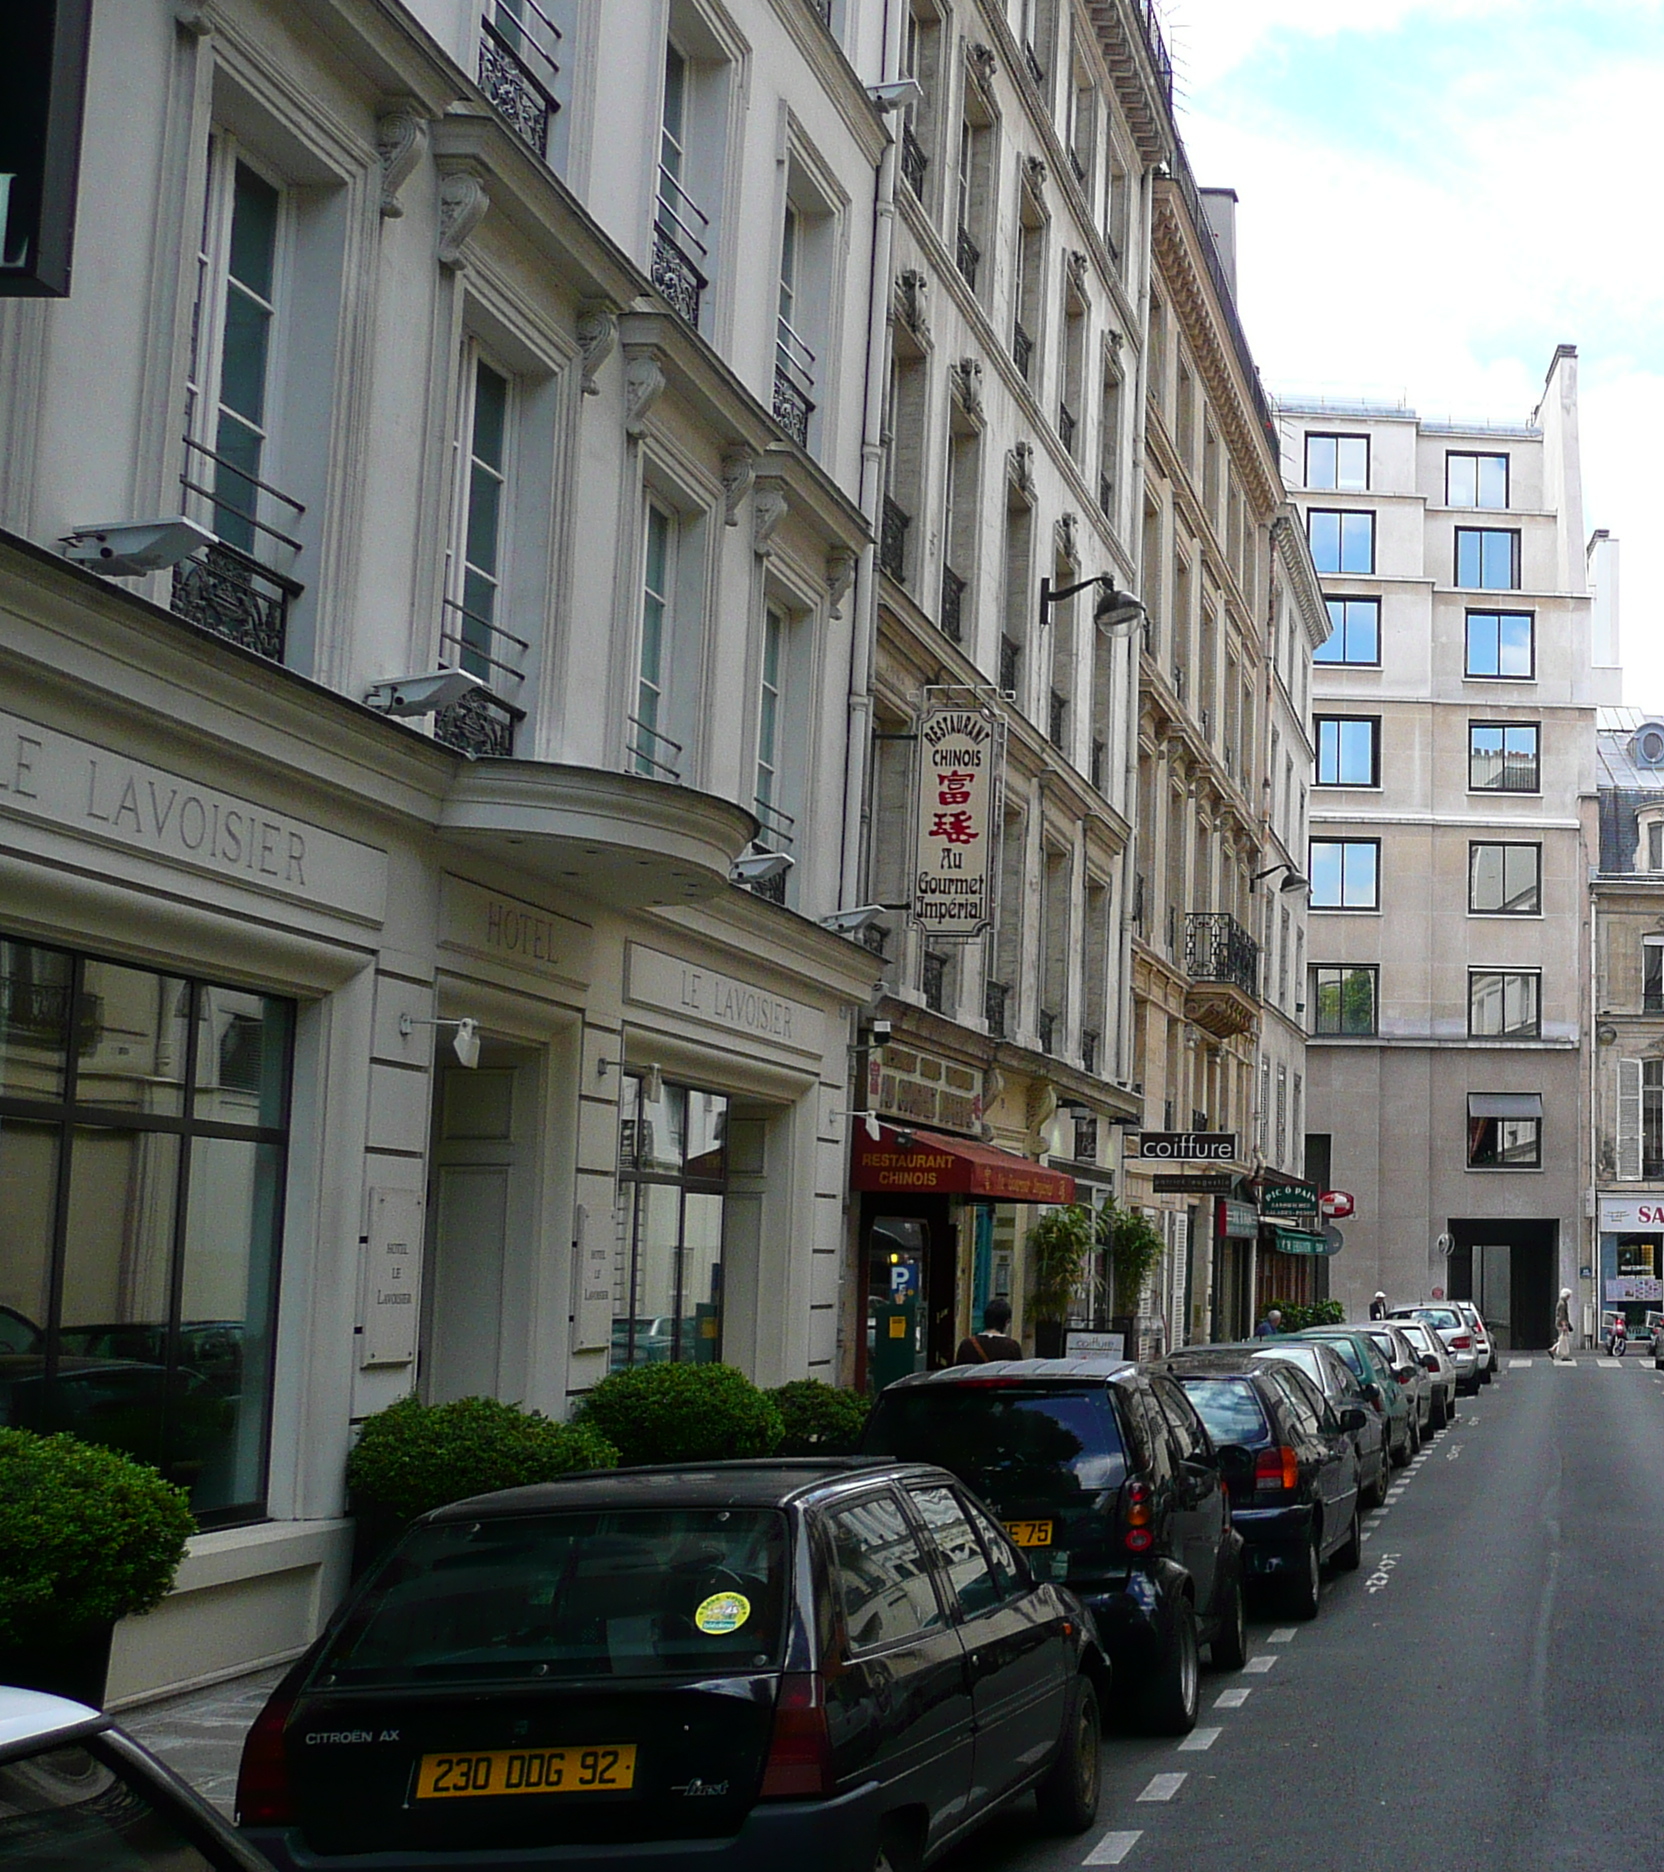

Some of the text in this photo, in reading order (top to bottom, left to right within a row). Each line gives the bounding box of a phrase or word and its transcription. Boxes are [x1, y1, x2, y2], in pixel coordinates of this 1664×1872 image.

[923, 714, 991, 748] RESTAURANT
[931, 748, 982, 768] CHINOIS
[0, 733, 307, 886] E LAVOISIER
[940, 847, 963, 870] Au
[918, 870, 985, 896] Gourmet
[916, 895, 983, 924] Impérial
[486, 901, 560, 965] HOTEL
[680, 970, 793, 1040] LE LAVOISIER
[1143, 1134, 1232, 1158] coiffure
[862, 1153, 955, 1169] RESTAURANT
[878, 1171, 938, 1186] CHINOIS
[1264, 1188, 1282, 1202] PIC
[1294, 1187, 1316, 1202] PAIN
[891, 1266, 910, 1290] P
[1025, 1522, 1050, 1543] 75
[305, 1729, 400, 1744] CITROËN AX
[432, 1750, 620, 1792] 230 DDG 92
